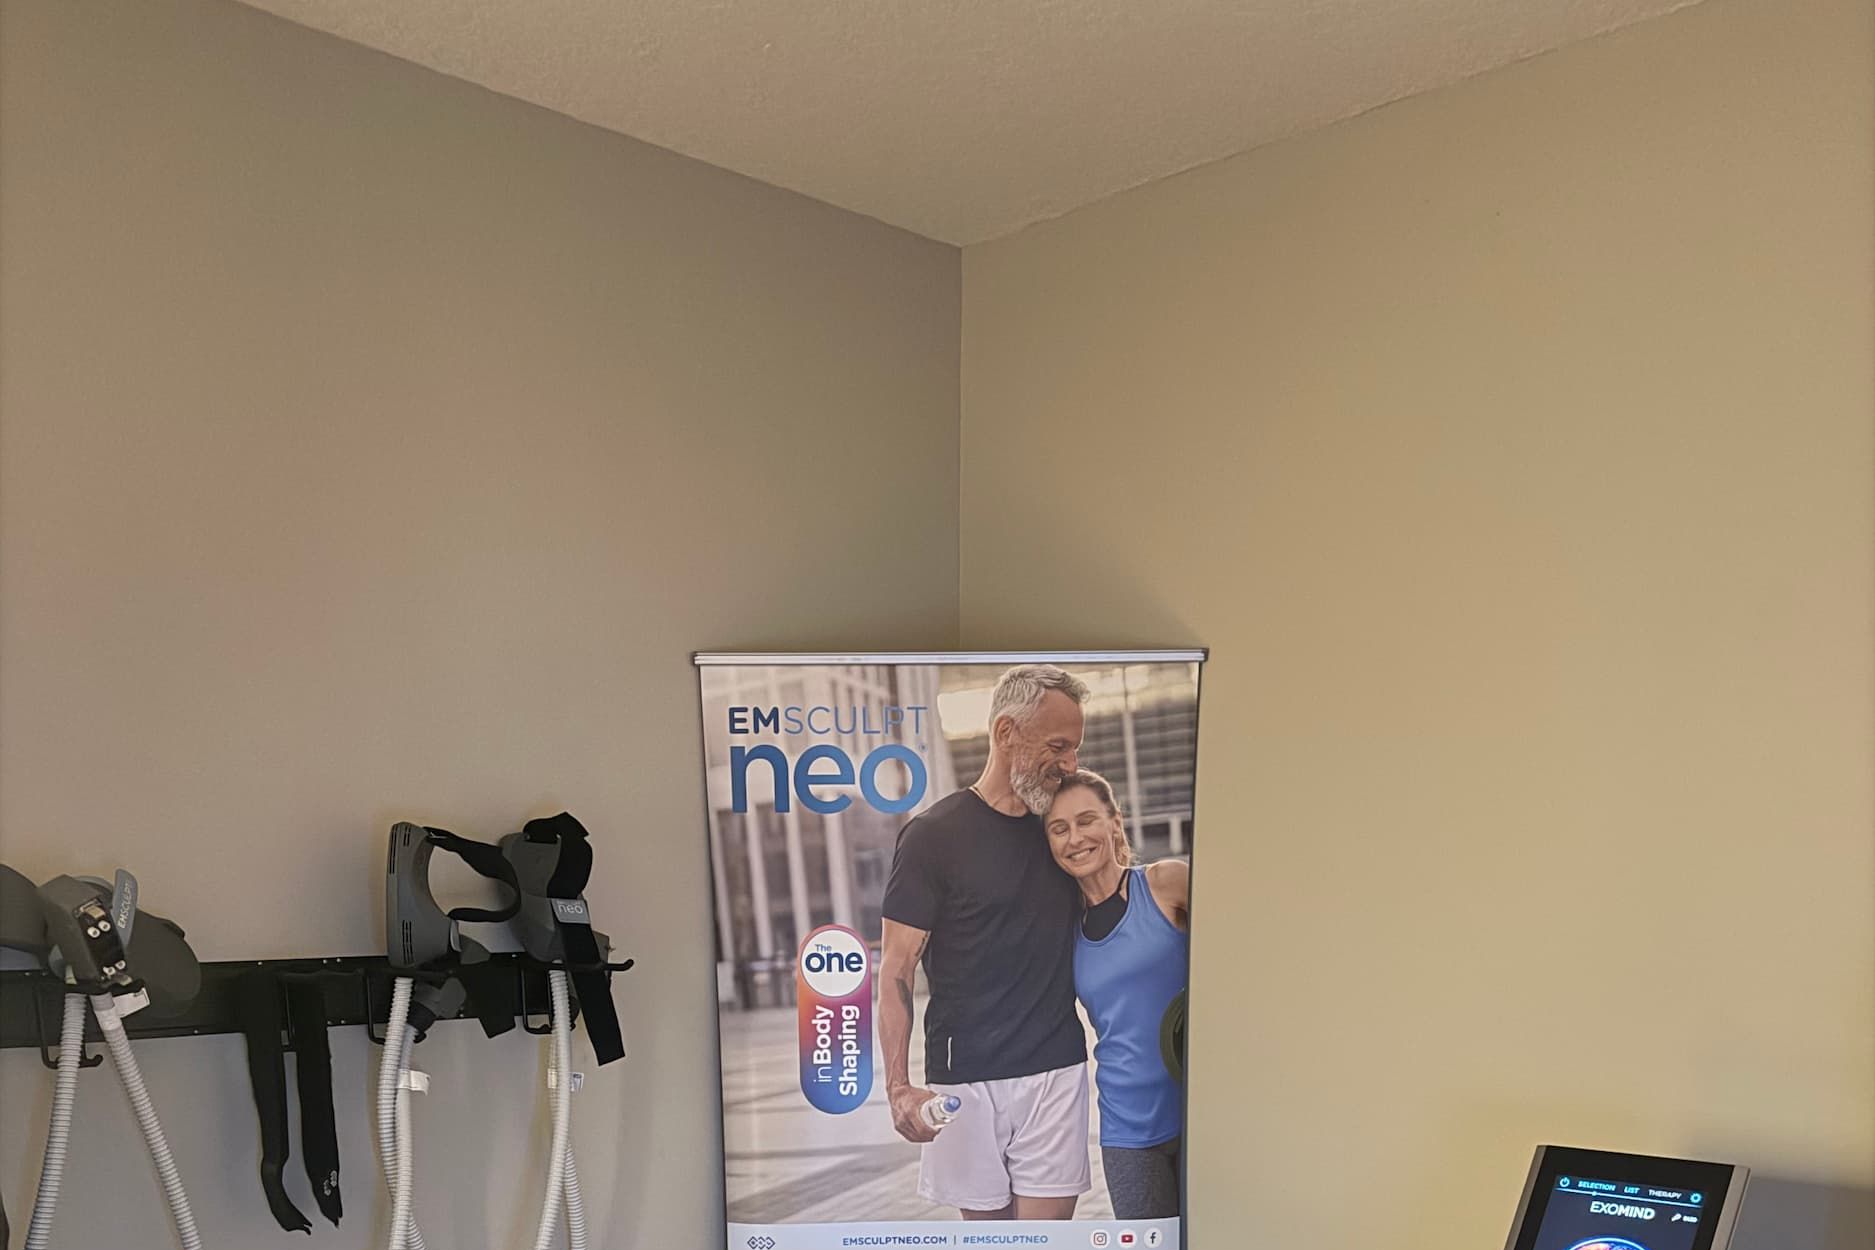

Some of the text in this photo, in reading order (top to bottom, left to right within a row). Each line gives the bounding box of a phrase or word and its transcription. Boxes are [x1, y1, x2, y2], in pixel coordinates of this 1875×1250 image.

[728, 706, 928, 734] EMSCULPT
[729, 744, 928, 814] neo
[558, 904, 583, 914] neo
[815, 943, 832, 952] The
[805, 951, 864, 973] one
[838, 1005, 860, 1096] Shaping
[1578, 1181, 1616, 1192] SELECTION
[1624, 1186, 1640, 1194] LIST
[1590, 1201, 1655, 1220] EXOMIND
[842, 1235, 1049, 1246] EMSCULPTNEO.COM #EMSCULPTNEO
